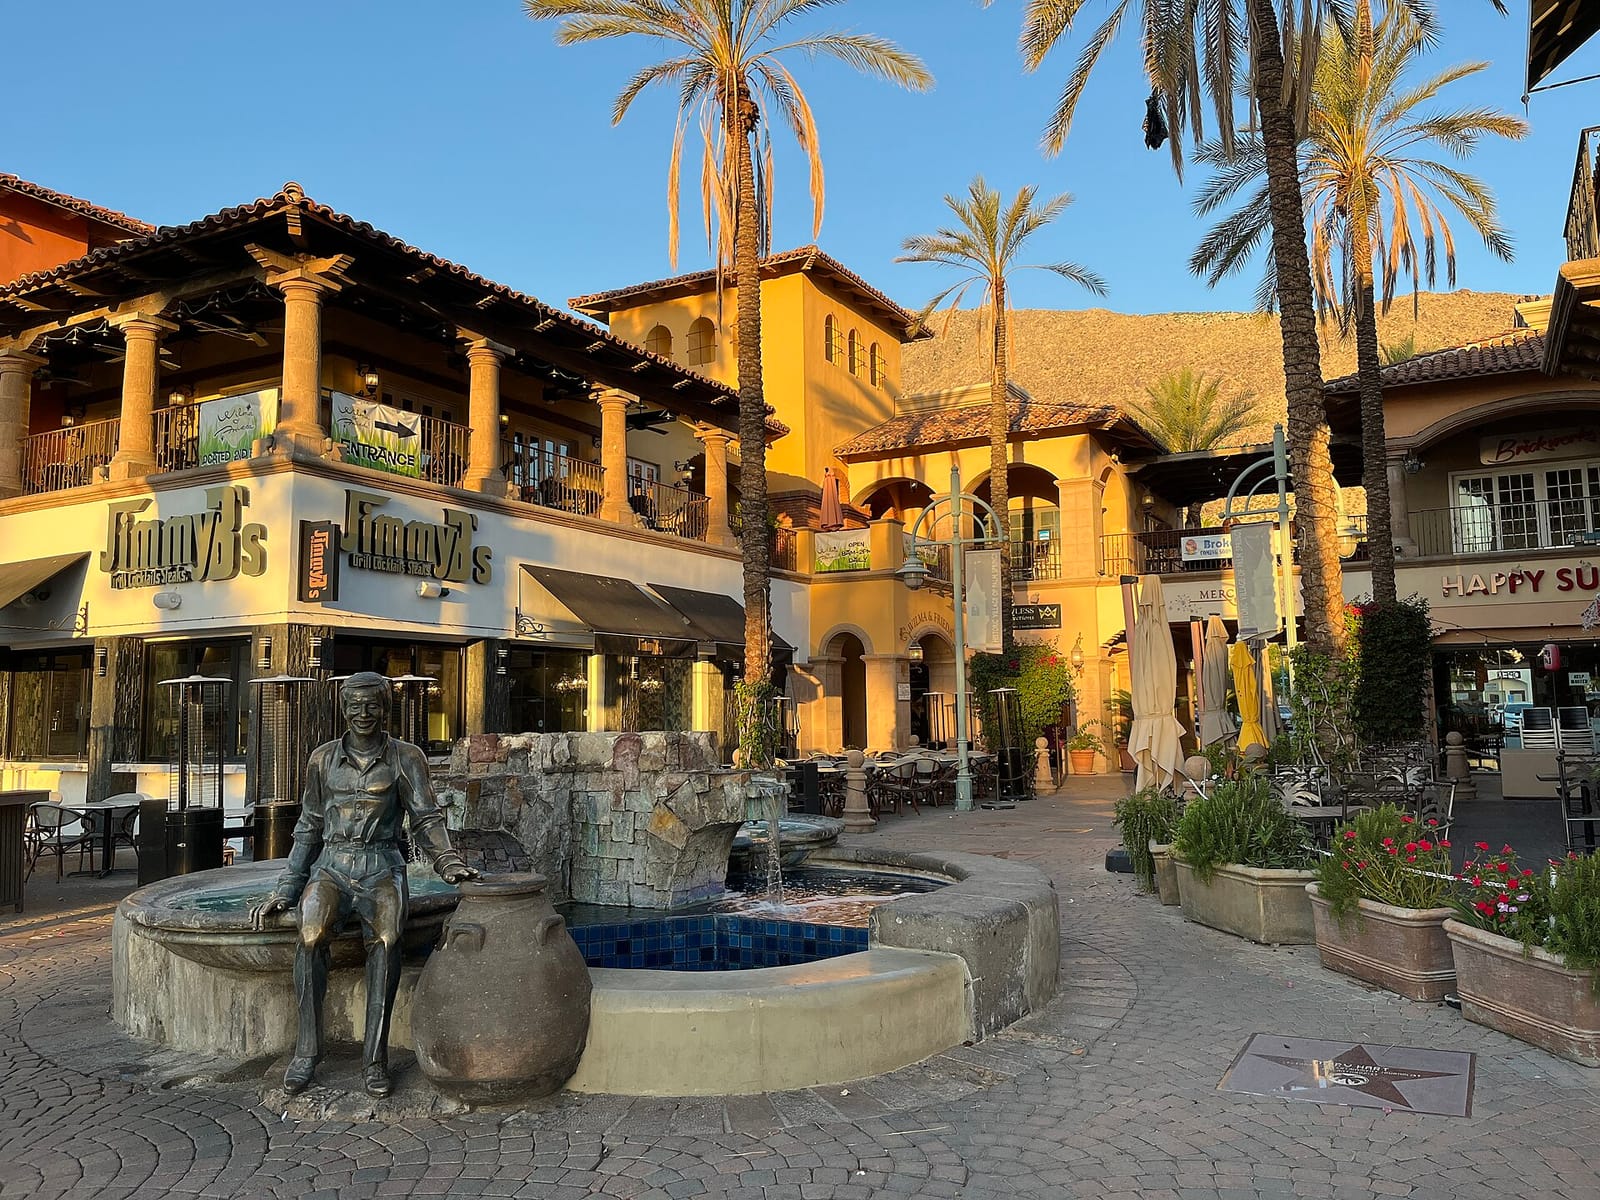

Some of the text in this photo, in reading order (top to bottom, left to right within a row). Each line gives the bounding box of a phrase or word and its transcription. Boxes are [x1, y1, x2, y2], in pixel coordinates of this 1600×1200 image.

[201, 451, 231, 465] OCATED
[341, 438, 415, 467] ENTRANCE
[100, 485, 268, 582] JimmyB's
[340, 489, 492, 585] JimmyB's
[1203, 538, 1231, 549] Brok
[308, 529, 329, 599] JimmyB's
[372, 556, 406, 574] Cocktails
[1200, 589, 1236, 600] MERC
[1442, 567, 1599, 597] HAPPY SU
